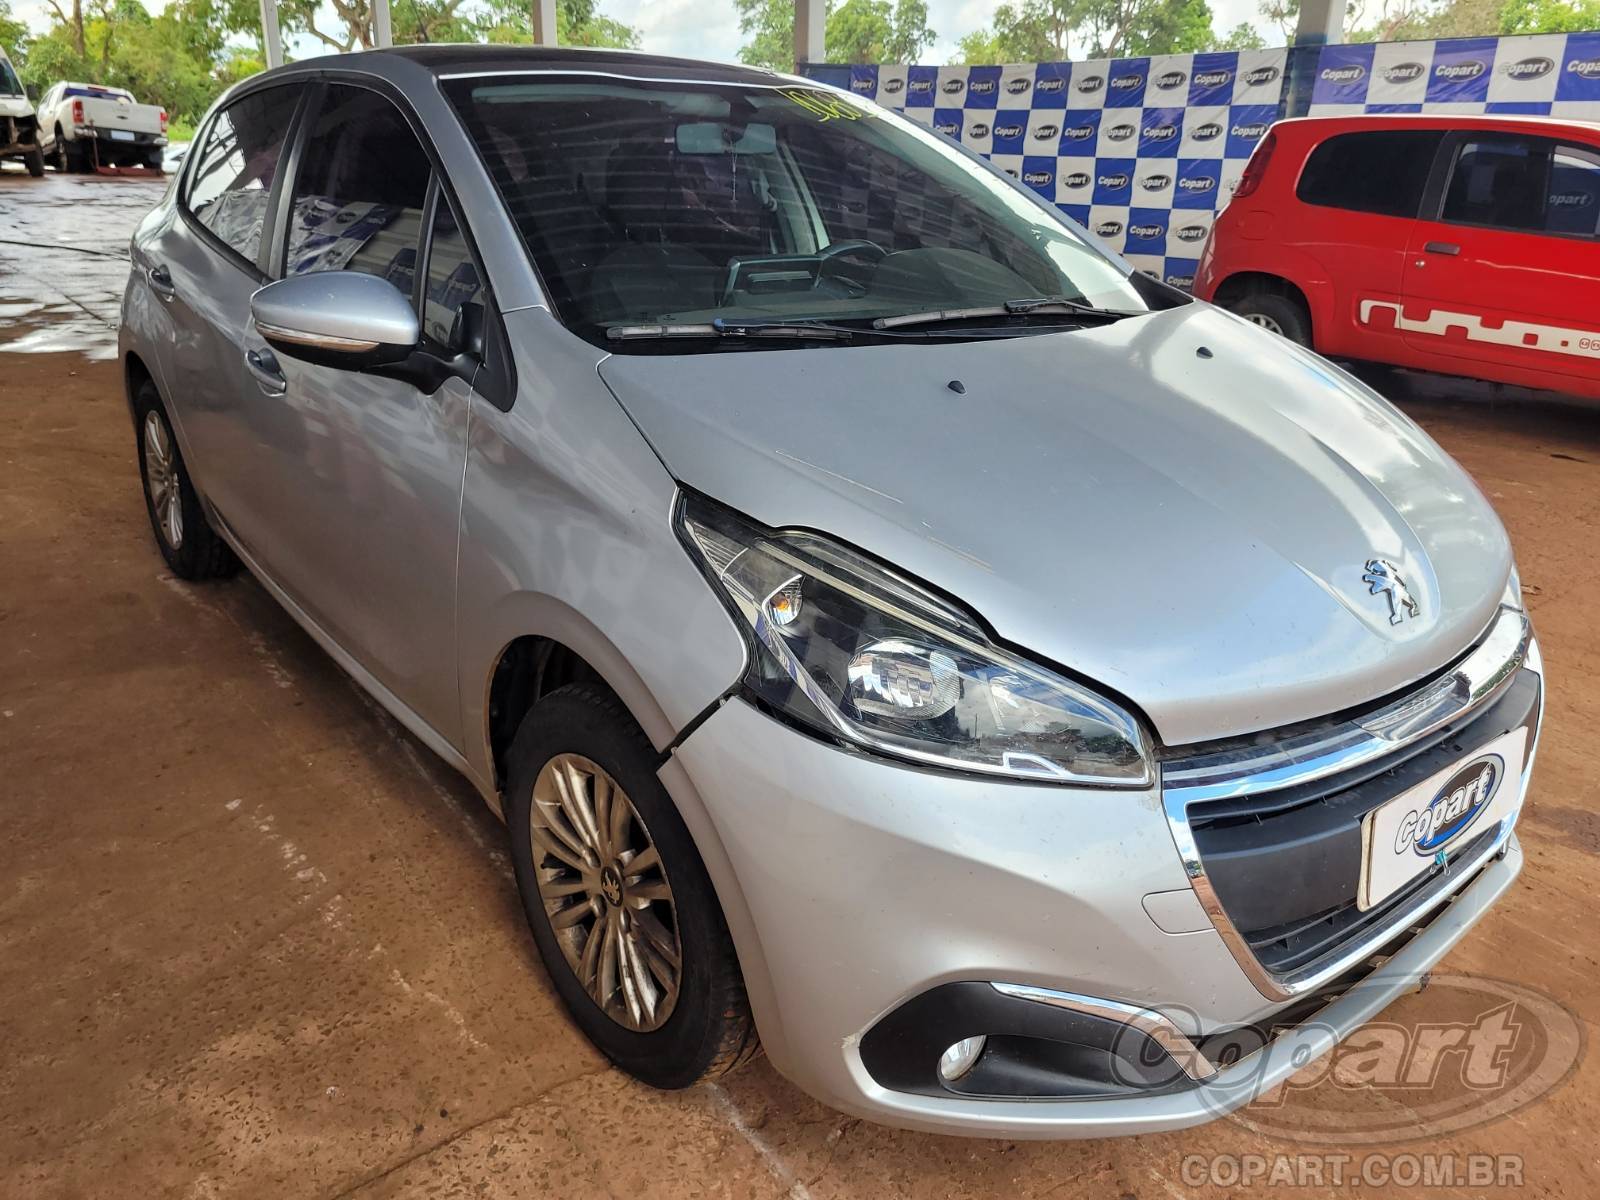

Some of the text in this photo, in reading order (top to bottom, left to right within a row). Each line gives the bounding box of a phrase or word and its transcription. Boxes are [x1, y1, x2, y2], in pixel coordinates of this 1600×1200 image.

[1377, 64, 1419, 81] Copart
[1435, 63, 1481, 80] Copart
[1500, 59, 1548, 77] Copart
[1567, 59, 1600, 79] Copa
[1194, 73, 1227, 86] Copart
[1321, 67, 1361, 83] Copart
[881, 80, 901, 91] opart
[909, 80, 932, 91] Copart
[940, 80, 962, 91] opart
[970, 81, 993, 92] Copart
[1003, 80, 1027, 91] opart
[1037, 80, 1063, 92] Copart
[1074, 79, 1100, 91] opart
[1111, 75, 1140, 90] Copart
[1152, 75, 1181, 88] opart
[967, 124, 986, 136] opart
[994, 126, 1021, 137] Copart
[1032, 127, 1056, 138] opart
[1064, 127, 1092, 138] Copart
[1143, 127, 1174, 139] Copart
[1187, 126, 1219, 139] opart
[1231, 125, 1266, 138] Copart
[1024, 173, 1050, 184] Copart
[1063, 174, 1087, 186] opart
[1098, 176, 1126, 187] Copart
[1139, 176, 1170, 188] opart
[1179, 178, 1211, 190] Copart
[1550, 194, 1588, 206] opart
[1095, 223, 1119, 235] opart
[1130, 225, 1161, 238] Copart
[1172, 228, 1204, 239] opart
[1167, 275, 1194, 287] Copar
[1394, 761, 1493, 855] Copart
